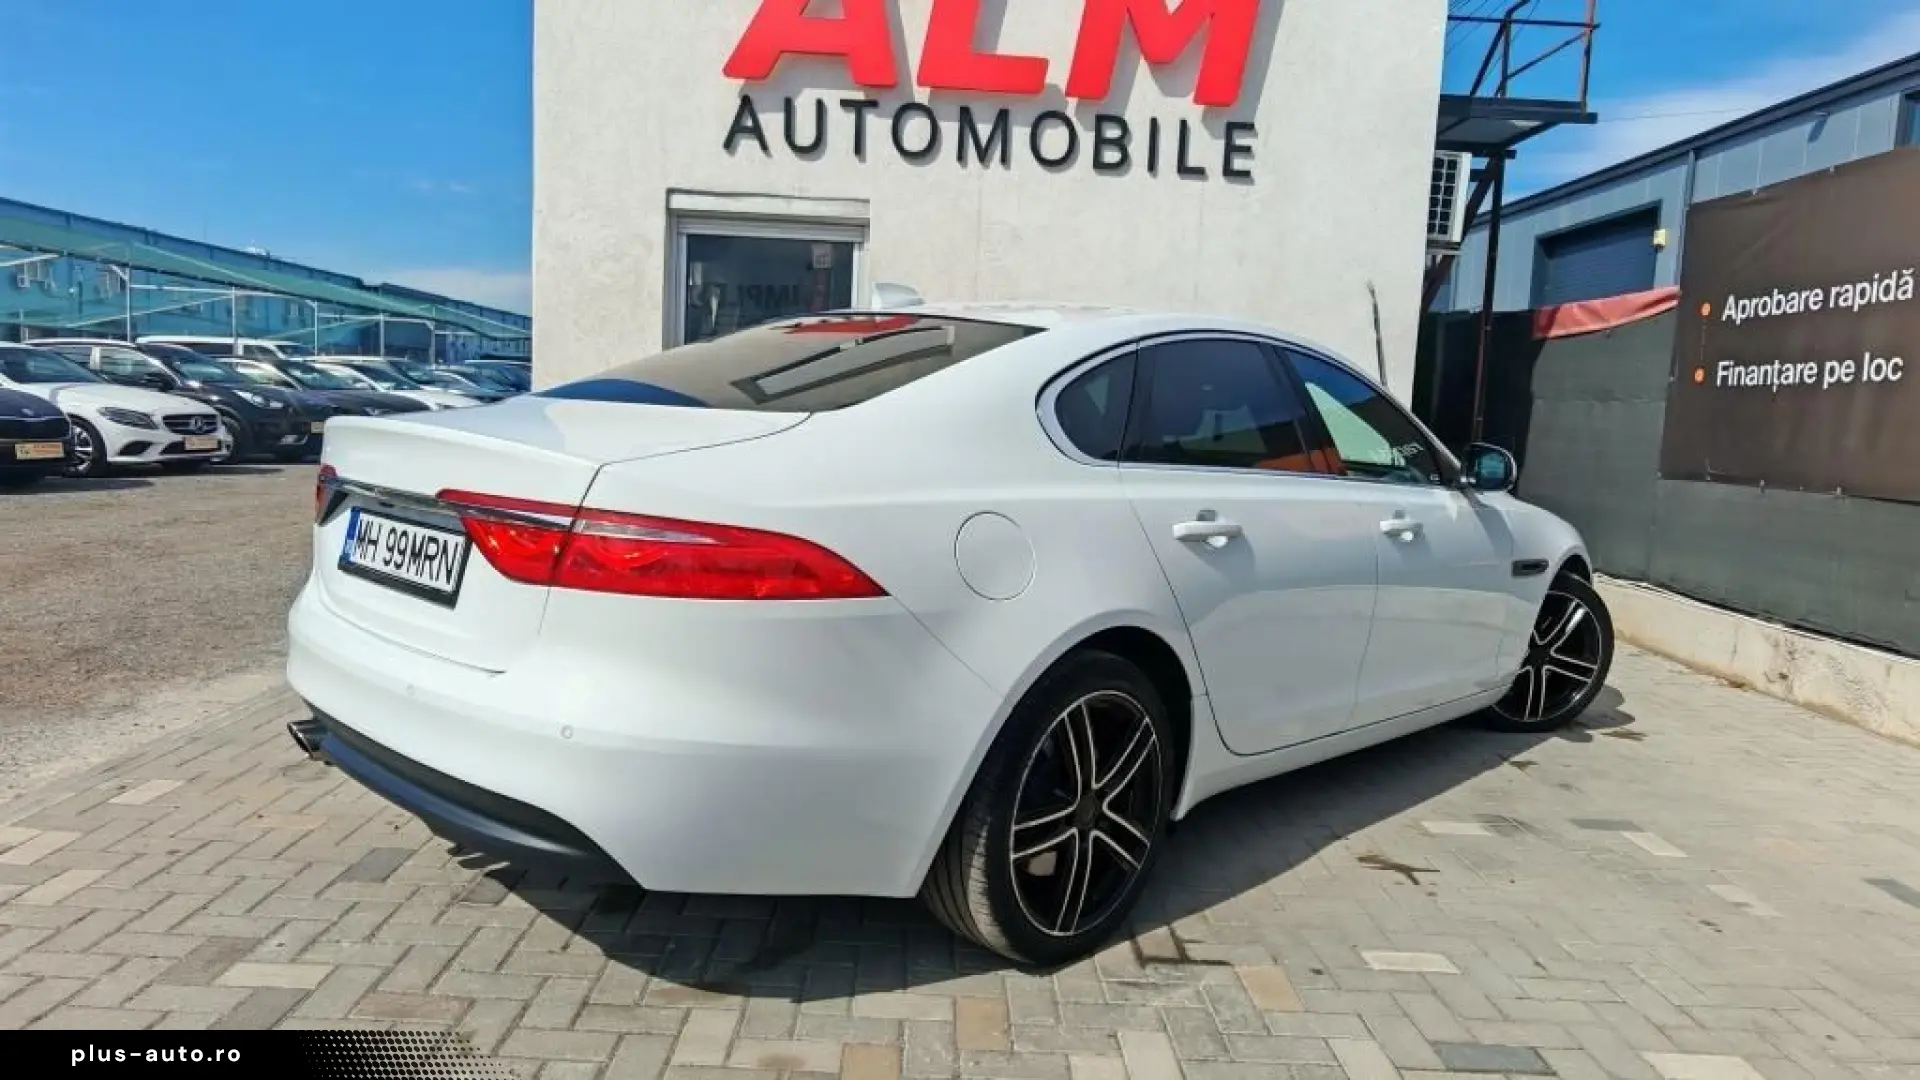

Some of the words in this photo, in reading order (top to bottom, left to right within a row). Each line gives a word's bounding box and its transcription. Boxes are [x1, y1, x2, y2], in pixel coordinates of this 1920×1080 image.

[723, 0, 1261, 107] ALM
[724, 94, 1257, 178] AUTOMOBILE
[1721, 288, 1824, 325] Aprobare
[1829, 268, 1915, 313] rapidă
[1716, 359, 1818, 393] Finanțare
[1823, 359, 1855, 390] pe
[1862, 351, 1904, 382] loc
[354, 519, 382, 563] MH
